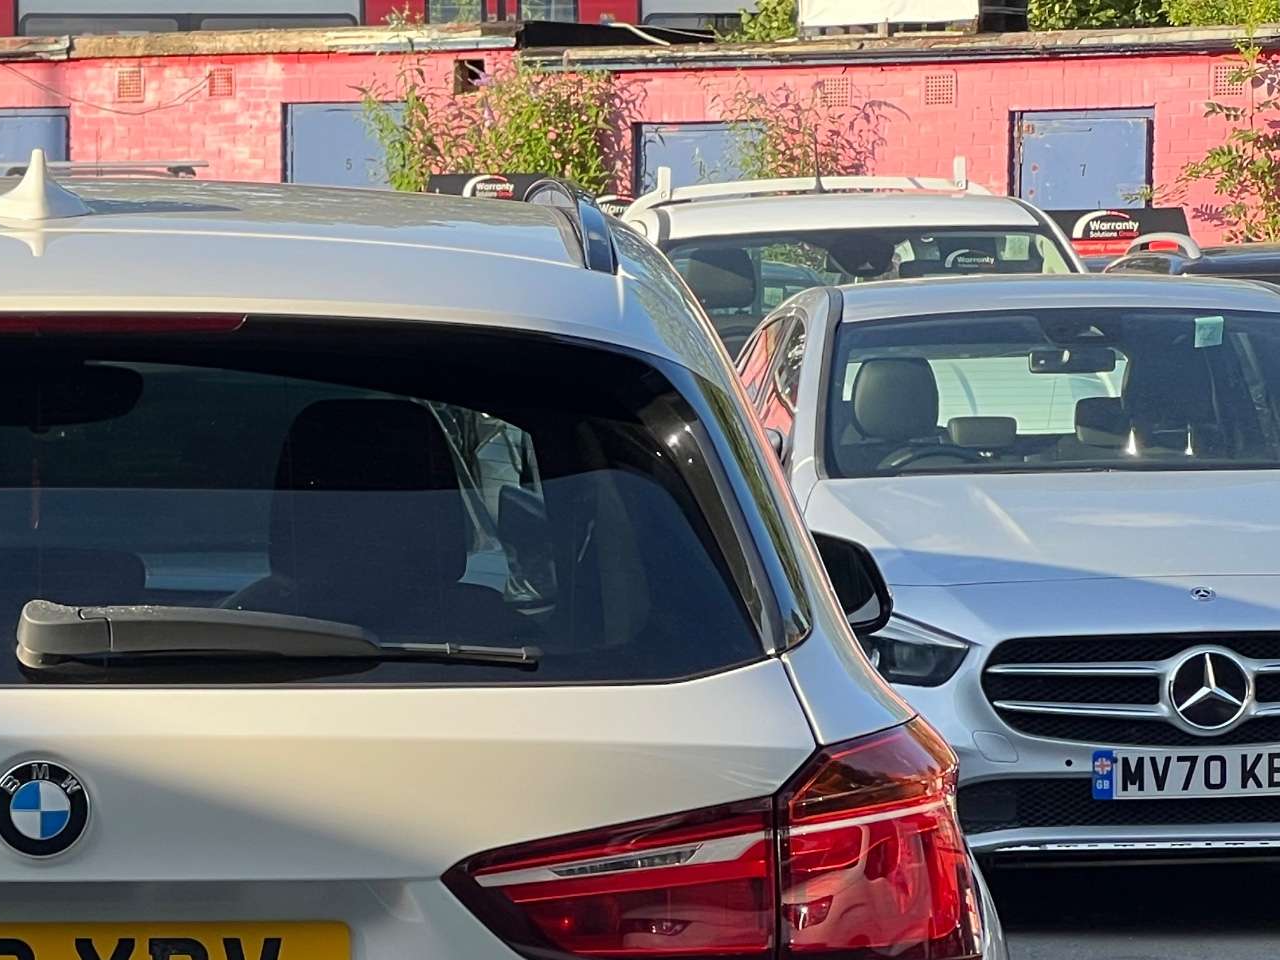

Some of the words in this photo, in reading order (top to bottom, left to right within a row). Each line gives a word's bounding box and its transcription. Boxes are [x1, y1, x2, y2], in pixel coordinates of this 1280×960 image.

[476, 182, 514, 194] Warranty
[1089, 220, 1139, 231] Warranty
[1089, 230, 1117, 238] Solutions
[0, 763, 82, 795] BMW
[1121, 755, 1226, 792] MV70
[1096, 780, 1110, 790] GB
